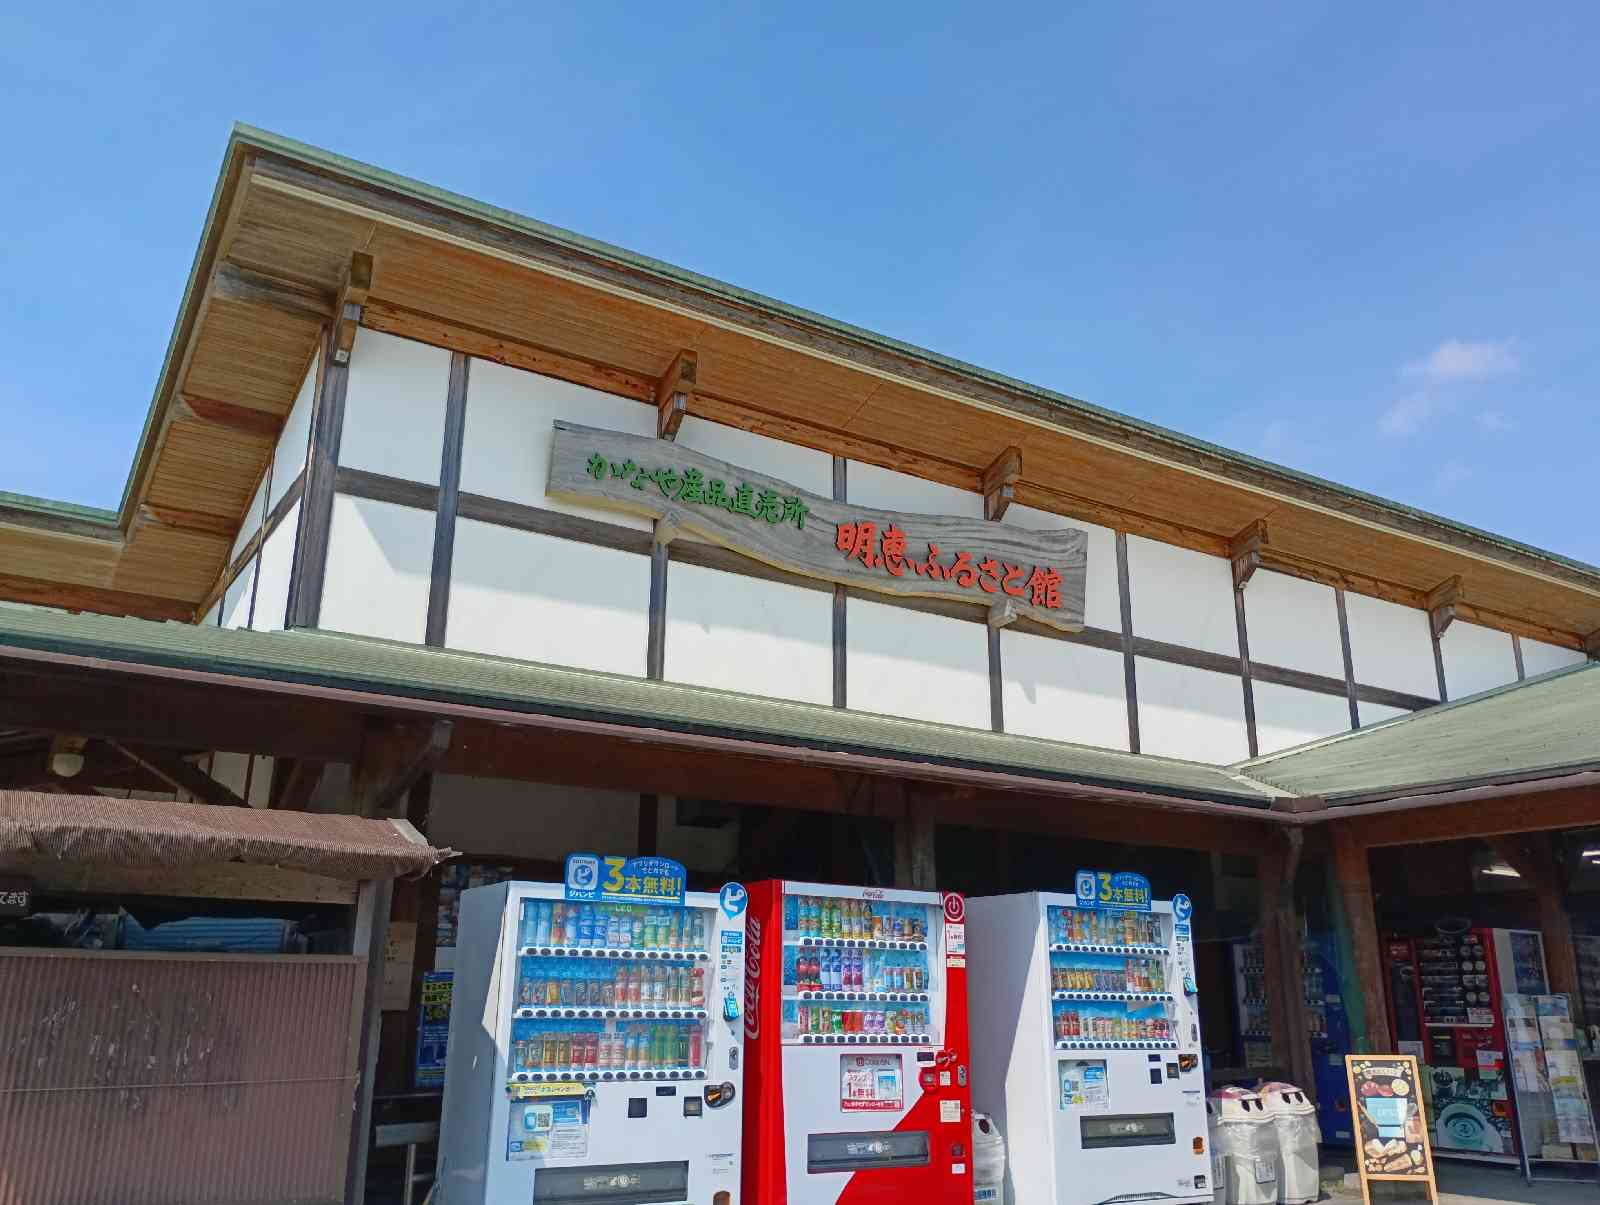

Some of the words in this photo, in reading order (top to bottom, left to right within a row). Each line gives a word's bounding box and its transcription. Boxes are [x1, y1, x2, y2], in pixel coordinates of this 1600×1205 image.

[835, 521, 1063, 609] 明恵ふるさと館
